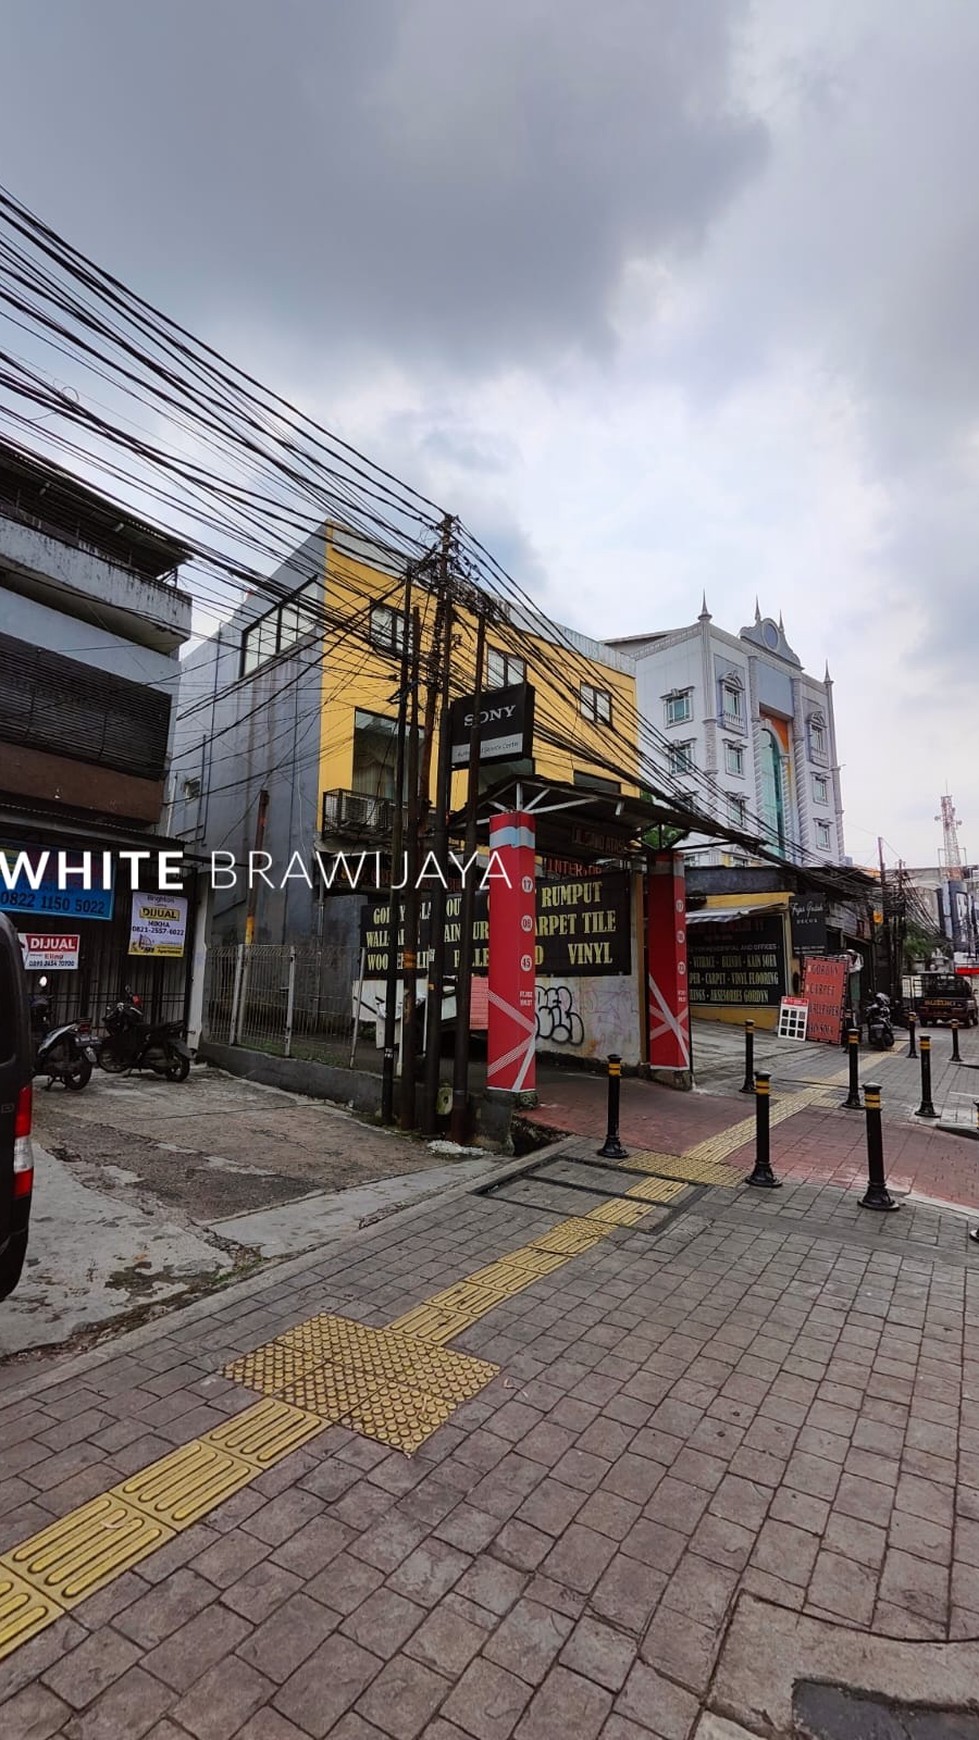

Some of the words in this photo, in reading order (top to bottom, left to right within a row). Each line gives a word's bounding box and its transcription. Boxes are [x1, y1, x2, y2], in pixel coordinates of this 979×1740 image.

[464, 705, 516, 727] SONY
[1, 891, 36, 908] 0822
[41, 895, 71, 911] 1150
[75, 899, 105, 914] 5022
[541, 881, 603, 908] RUMPUT
[142, 907, 177, 919] DIJUAL
[535, 913, 577, 936] RPET
[582, 910, 616, 934] TILE
[30, 938, 76, 950] DIJUAL
[568, 942, 613, 965] VINYL
[522, 957, 531, 968] 45
